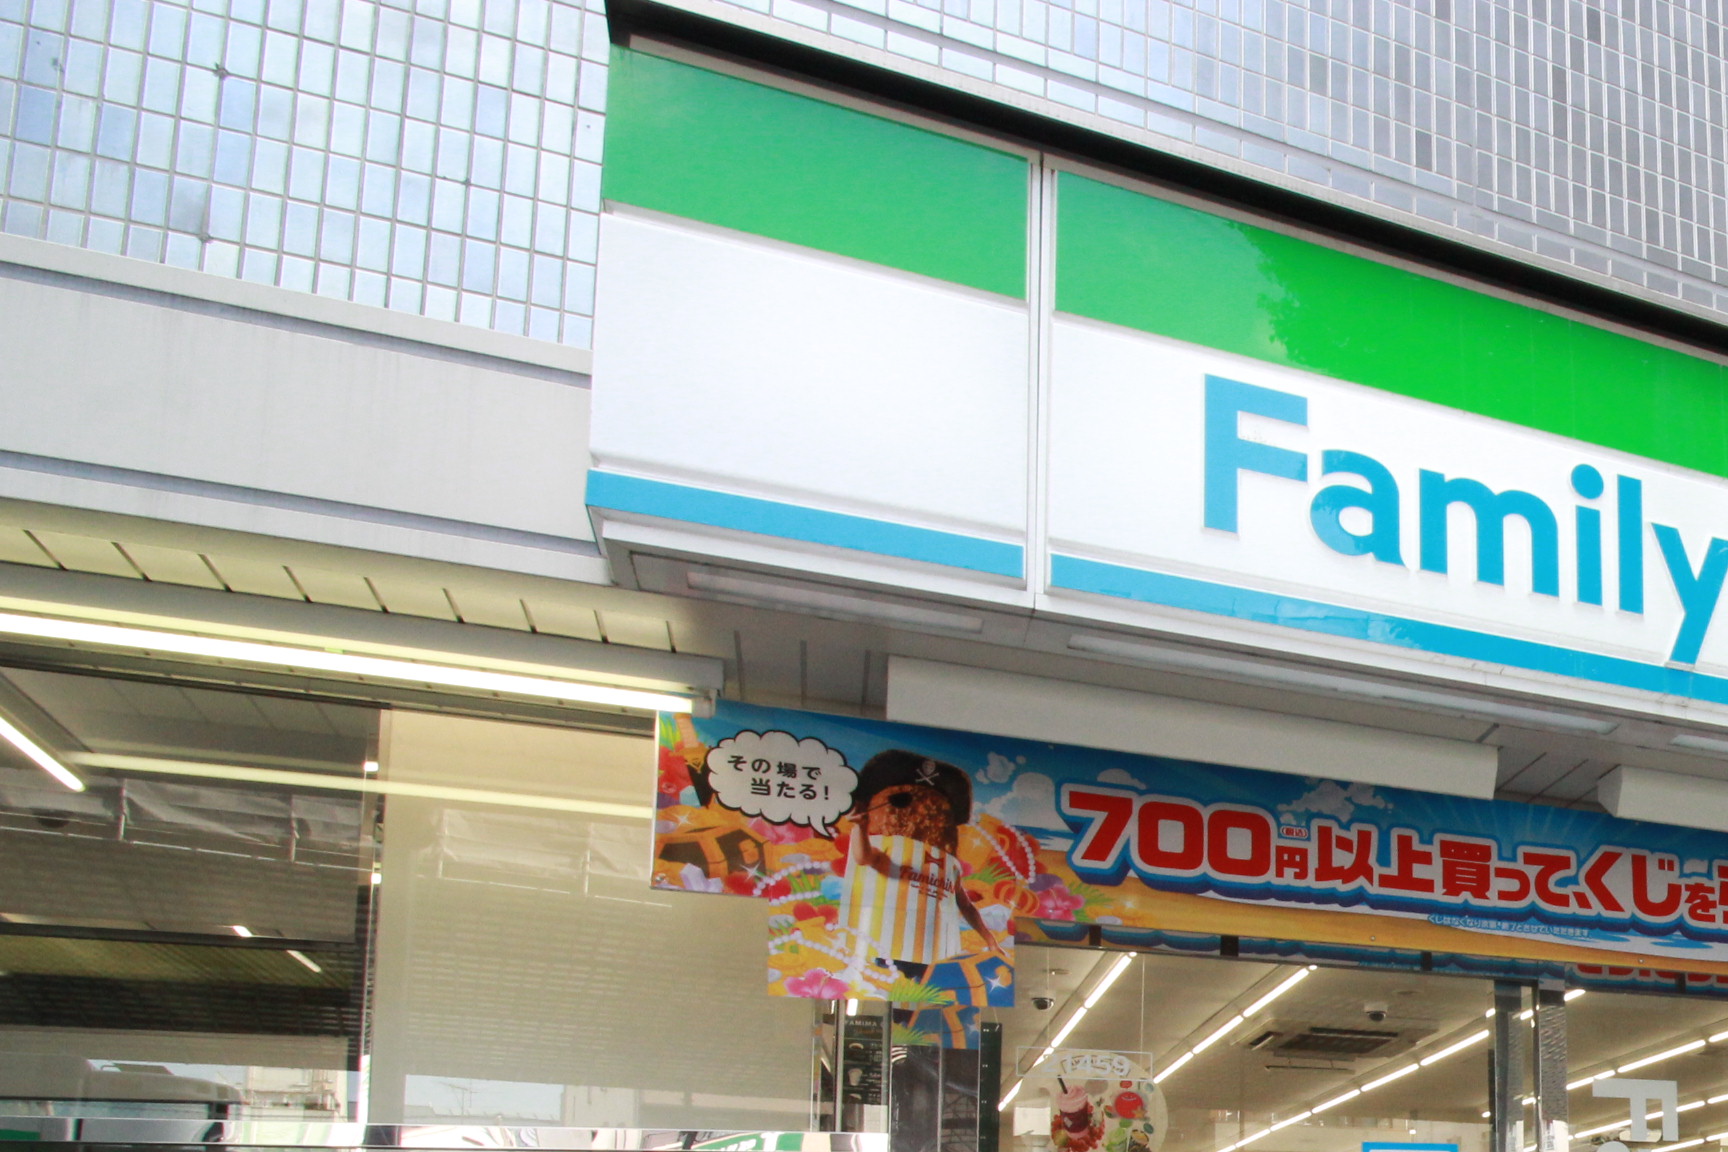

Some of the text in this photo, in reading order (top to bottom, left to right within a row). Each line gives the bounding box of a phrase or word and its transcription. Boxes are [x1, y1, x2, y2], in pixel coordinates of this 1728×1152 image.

[728, 755, 822, 780] その場で
[751, 777, 829, 800] 当たる!
